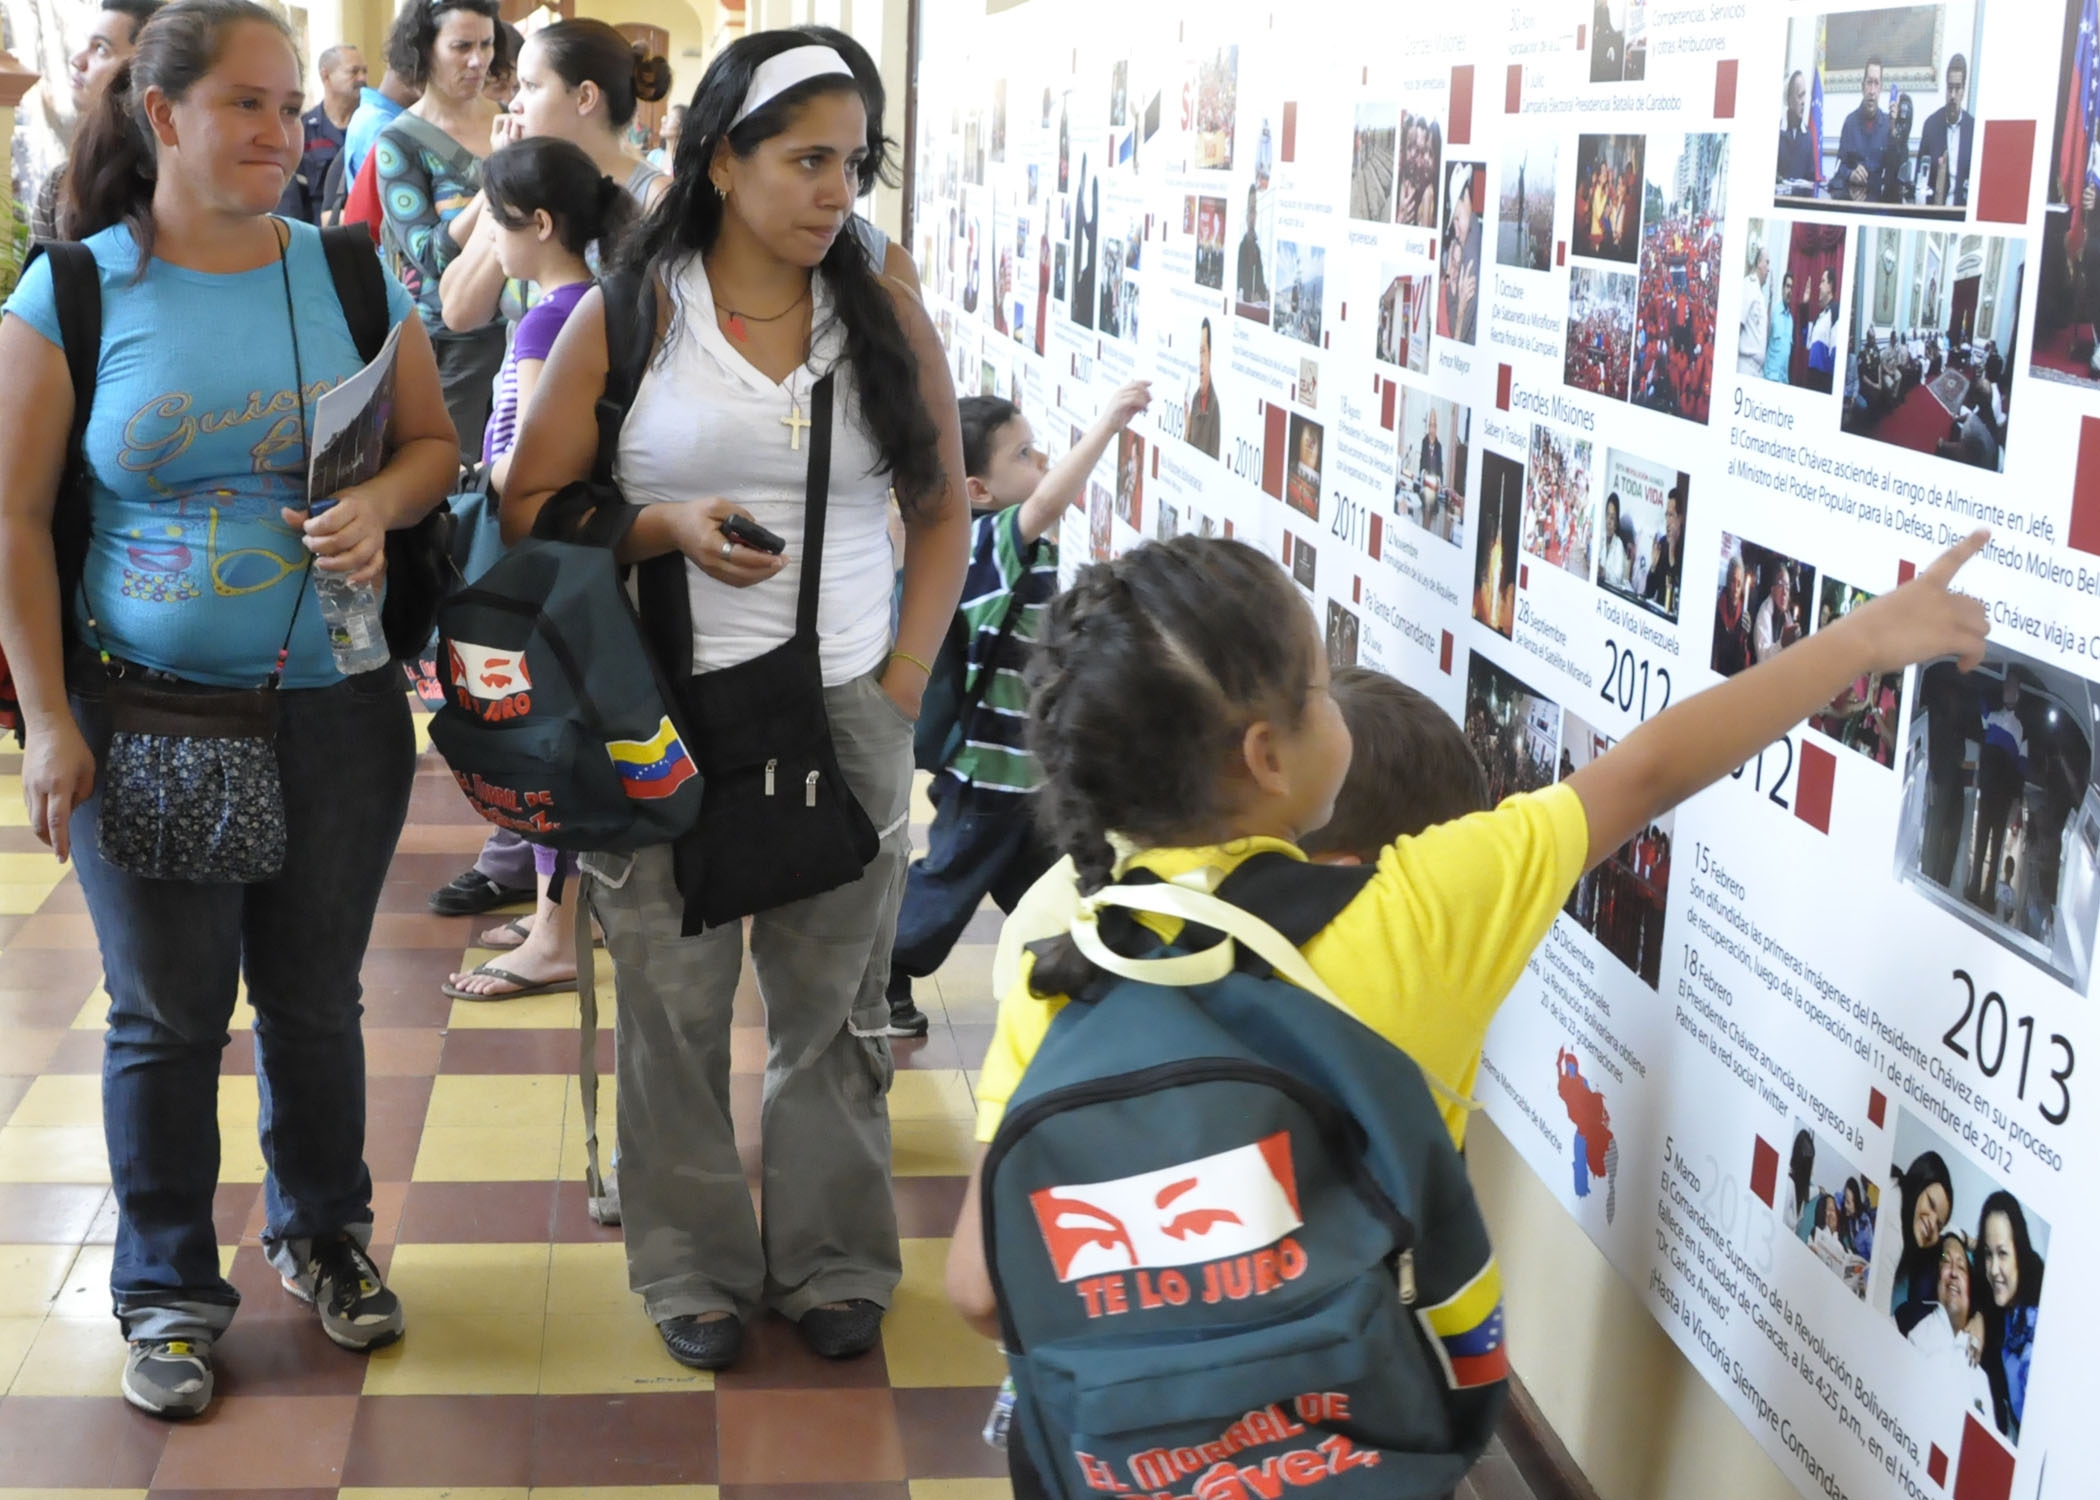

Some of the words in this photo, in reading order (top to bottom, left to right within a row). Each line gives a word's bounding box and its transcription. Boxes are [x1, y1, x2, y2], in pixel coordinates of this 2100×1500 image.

[1645, 93, 1681, 111] Carabobo
[1162, 398, 1184, 440] 2009
[1511, 381, 1550, 417] Grandes
[1550, 393, 1595, 432] Misiones
[1733, 386, 1743, 416] 9
[1742, 396, 1795, 431] Diciembre
[1234, 436, 1262, 487] 2010
[1613, 473, 1619, 489] A
[1621, 475, 1642, 499] TODA
[1644, 486, 1663, 508] VIDA
[1729, 425, 1739, 446] El
[1738, 428, 1797, 464] Comandante
[1797, 445, 1834, 475] Chávez
[1833, 460, 1880, 489] asciende
[1879, 471, 1891, 492] al
[1892, 478, 1926, 506] rango
[1926, 484, 1943, 508] de
[1943, 488, 2005, 527] Almirante
[2006, 511, 2024, 532] en
[2025, 513, 2056, 545] Jefe,
[1331, 491, 1366, 552] 2011
[1727, 457, 1737, 476] al
[1736, 459, 1773, 488] Ministro
[1772, 471, 1789, 493] del
[1788, 475, 1818, 502] Poder
[1817, 484, 1858, 515] Popular
[1857, 502, 1882, 524] para
[1883, 505, 1894, 528] la
[1894, 508, 1935, 544] Defesa,
[2024, 550, 2075, 588] Molero
[1516, 597, 1530, 625] 28
[1528, 610, 1567, 647] Septiembre
[1595, 597, 1605, 616] A
[1602, 599, 1621, 626] Toda
[1621, 609, 1639, 635] Vida
[1638, 619, 1680, 657] Venezuela
[1993, 599, 2042, 638] Chávez
[2043, 620, 2075, 654] viaja
[2076, 635, 2087, 655] a
[1600, 638, 1671, 722] 2012
[1731, 735, 1793, 810] 12
[1694, 840, 1711, 875] 15
[1709, 859, 1746, 902] Febrero
[1558, 928, 1595, 976] Diciembre
[1683, 942, 1699, 977] 18
[1697, 962, 1733, 1007] Febrero
[1540, 990, 1549, 1008] 20
[1550, 1002, 1558, 1019] de
[1557, 1007, 1567, 1028] las
[1567, 1017, 1576, 1036] 23
[1576, 1029, 1623, 1084] gobernaciones
[1542, 967, 1550, 985] La
[1549, 973, 1583, 1016] Revolución
[1583, 1006, 1618, 1052] Bolivariana
[1618, 1044, 1646, 1079] obtiene
[1675, 1004, 1697, 1037] Patria
[1697, 1029, 1708, 1047] en
[1709, 1034, 1717, 1055] la
[1717, 1046, 1732, 1068] red
[1732, 1059, 1757, 1089] social
[1758, 1076, 1789, 1117] Twitter
[1677, 977, 1686, 997] El
[1686, 984, 1728, 1034] Presidente
[1728, 1021, 1760, 1061] Chávez
[1759, 1052, 1795, 1092] anuncia
[1795, 1083, 1808, 1103] su
[1808, 1094, 1845, 1135] regreso
[1845, 1126, 1853, 1142] a
[1854, 1127, 1864, 1152] la
[1686, 906, 1698, 927] de
[1697, 917, 1753, 972] recuperación,
[1753, 955, 1780, 991] luego
[1779, 978, 1794, 1002] de
[1793, 986, 1803, 1010] la
[1803, 999, 1853, 1048] operación
[1852, 1035, 1872, 1062] del
[1873, 1048, 1886, 1074] 11
[1886, 1061, 1903, 1088] de
[1902, 1073, 1961, 1134] diciembre
[1961, 1120, 1979, 1148] de
[1979, 1132, 2013, 1175] 2012
[1688, 876, 1706, 903] Son
[1705, 890, 1750, 936] difundidas
[1749, 921, 1763, 946] las
[1761, 935, 1803, 977] primeras
[1803, 961, 1852, 1013] imágenes
[1851, 999, 1870, 1026] del
[1869, 1010, 1928, 1071] Presidente
[1928, 1056, 1973, 1105] Chávez
[1972, 1093, 1990, 1118] en
[1990, 1106, 2008, 1131] su
[2007, 1120, 2063, 1172] proceso
[1942, 968, 2076, 1126] 2013
[1663, 1135, 1674, 1163] 5
[1673, 1151, 1701, 1193] Marzo
[1700, 1153, 1776, 1276] 2013
[1076, 1273, 1129, 1319] TE
[1135, 1268, 1191, 1309] LO
[1202, 1236, 1308, 1305] JURO
[1655, 1228, 1669, 1258] "Dr.
[1670, 1246, 1696, 1288] Carlos
[1696, 1276, 1730, 1325] Arvelo".
[1648, 1267, 1680, 1316] ¡Hasta
[1680, 1299, 1691, 1328] la
[1691, 1311, 1731, 1375] Victoria
[1730, 1360, 1779, 1432] Siempre
[1657, 1199, 1684, 1241] fallece
[1684, 1234, 1696, 1255] en
[1697, 1241, 1705, 1265] la
[1706, 1257, 1737, 1299] ciudad
[1737, 1290, 1750, 1315] de
[1751, 1303, 1790, 1362] Caracas,
[1791, 1351, 1798, 1368] a
[1799, 1354, 1814, 1385] las
[1814, 1375, 1839, 1411] 4:25
[1838, 1404, 1865, 1446] p.m.,
[1868, 1436, 1883, 1463] en
[1885, 1455, 1897, 1477] el
[1660, 1170, 1669, 1193] El
[1669, 1181, 1725, 1252] Comandante
[1725, 1239, 1768, 1298] Supremo
[1768, 1288, 1782, 1315] de
[1783, 1300, 1793, 1326] la
[1794, 1312, 1852, 1390] Revolución
[1854, 1376, 1920, 1467] Bolivariana,
[1074, 1450, 1132, 1493] EL
[1295, 1391, 1352, 1425] DE
